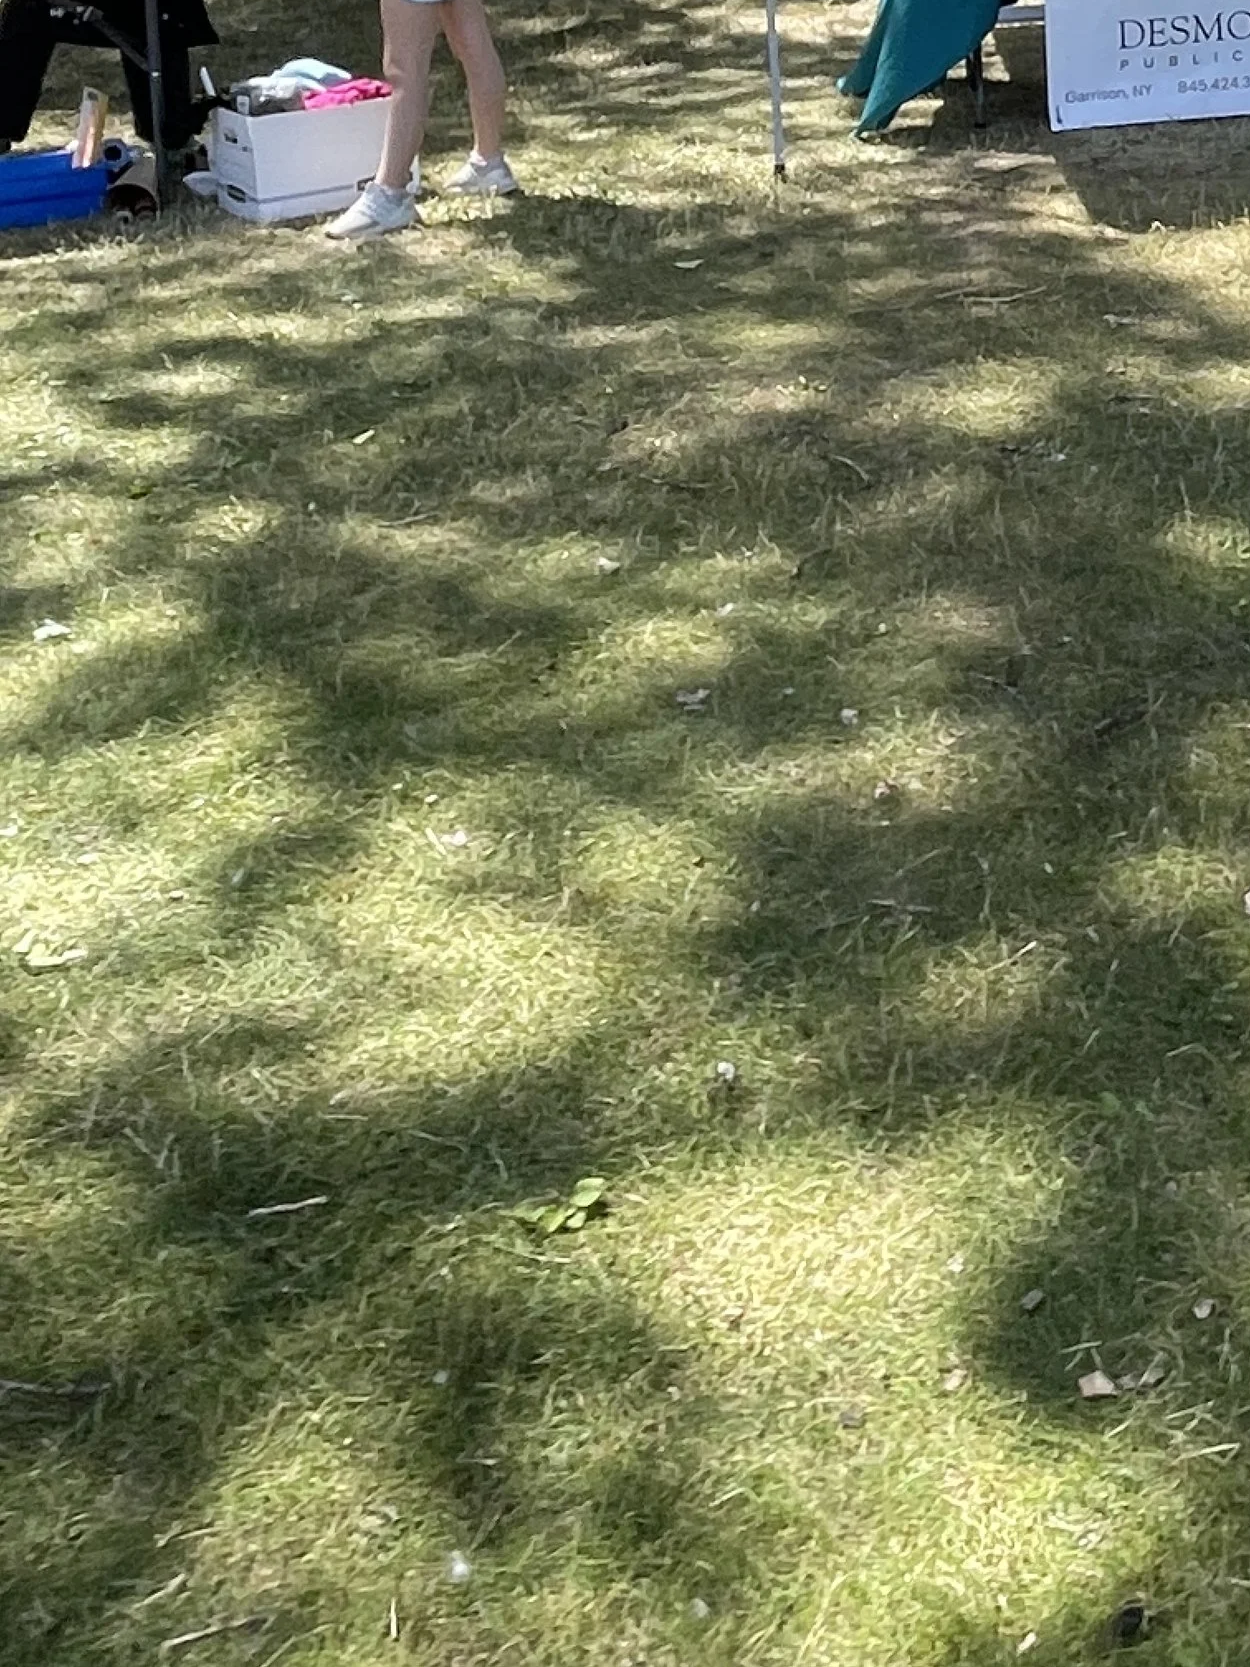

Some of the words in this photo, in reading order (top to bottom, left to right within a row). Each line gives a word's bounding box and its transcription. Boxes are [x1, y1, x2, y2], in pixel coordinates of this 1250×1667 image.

[1120, 50, 1243, 70] PUBLIC
[1065, 87, 1129, 103] Garrison,
[1133, 84, 1152, 98] NY
